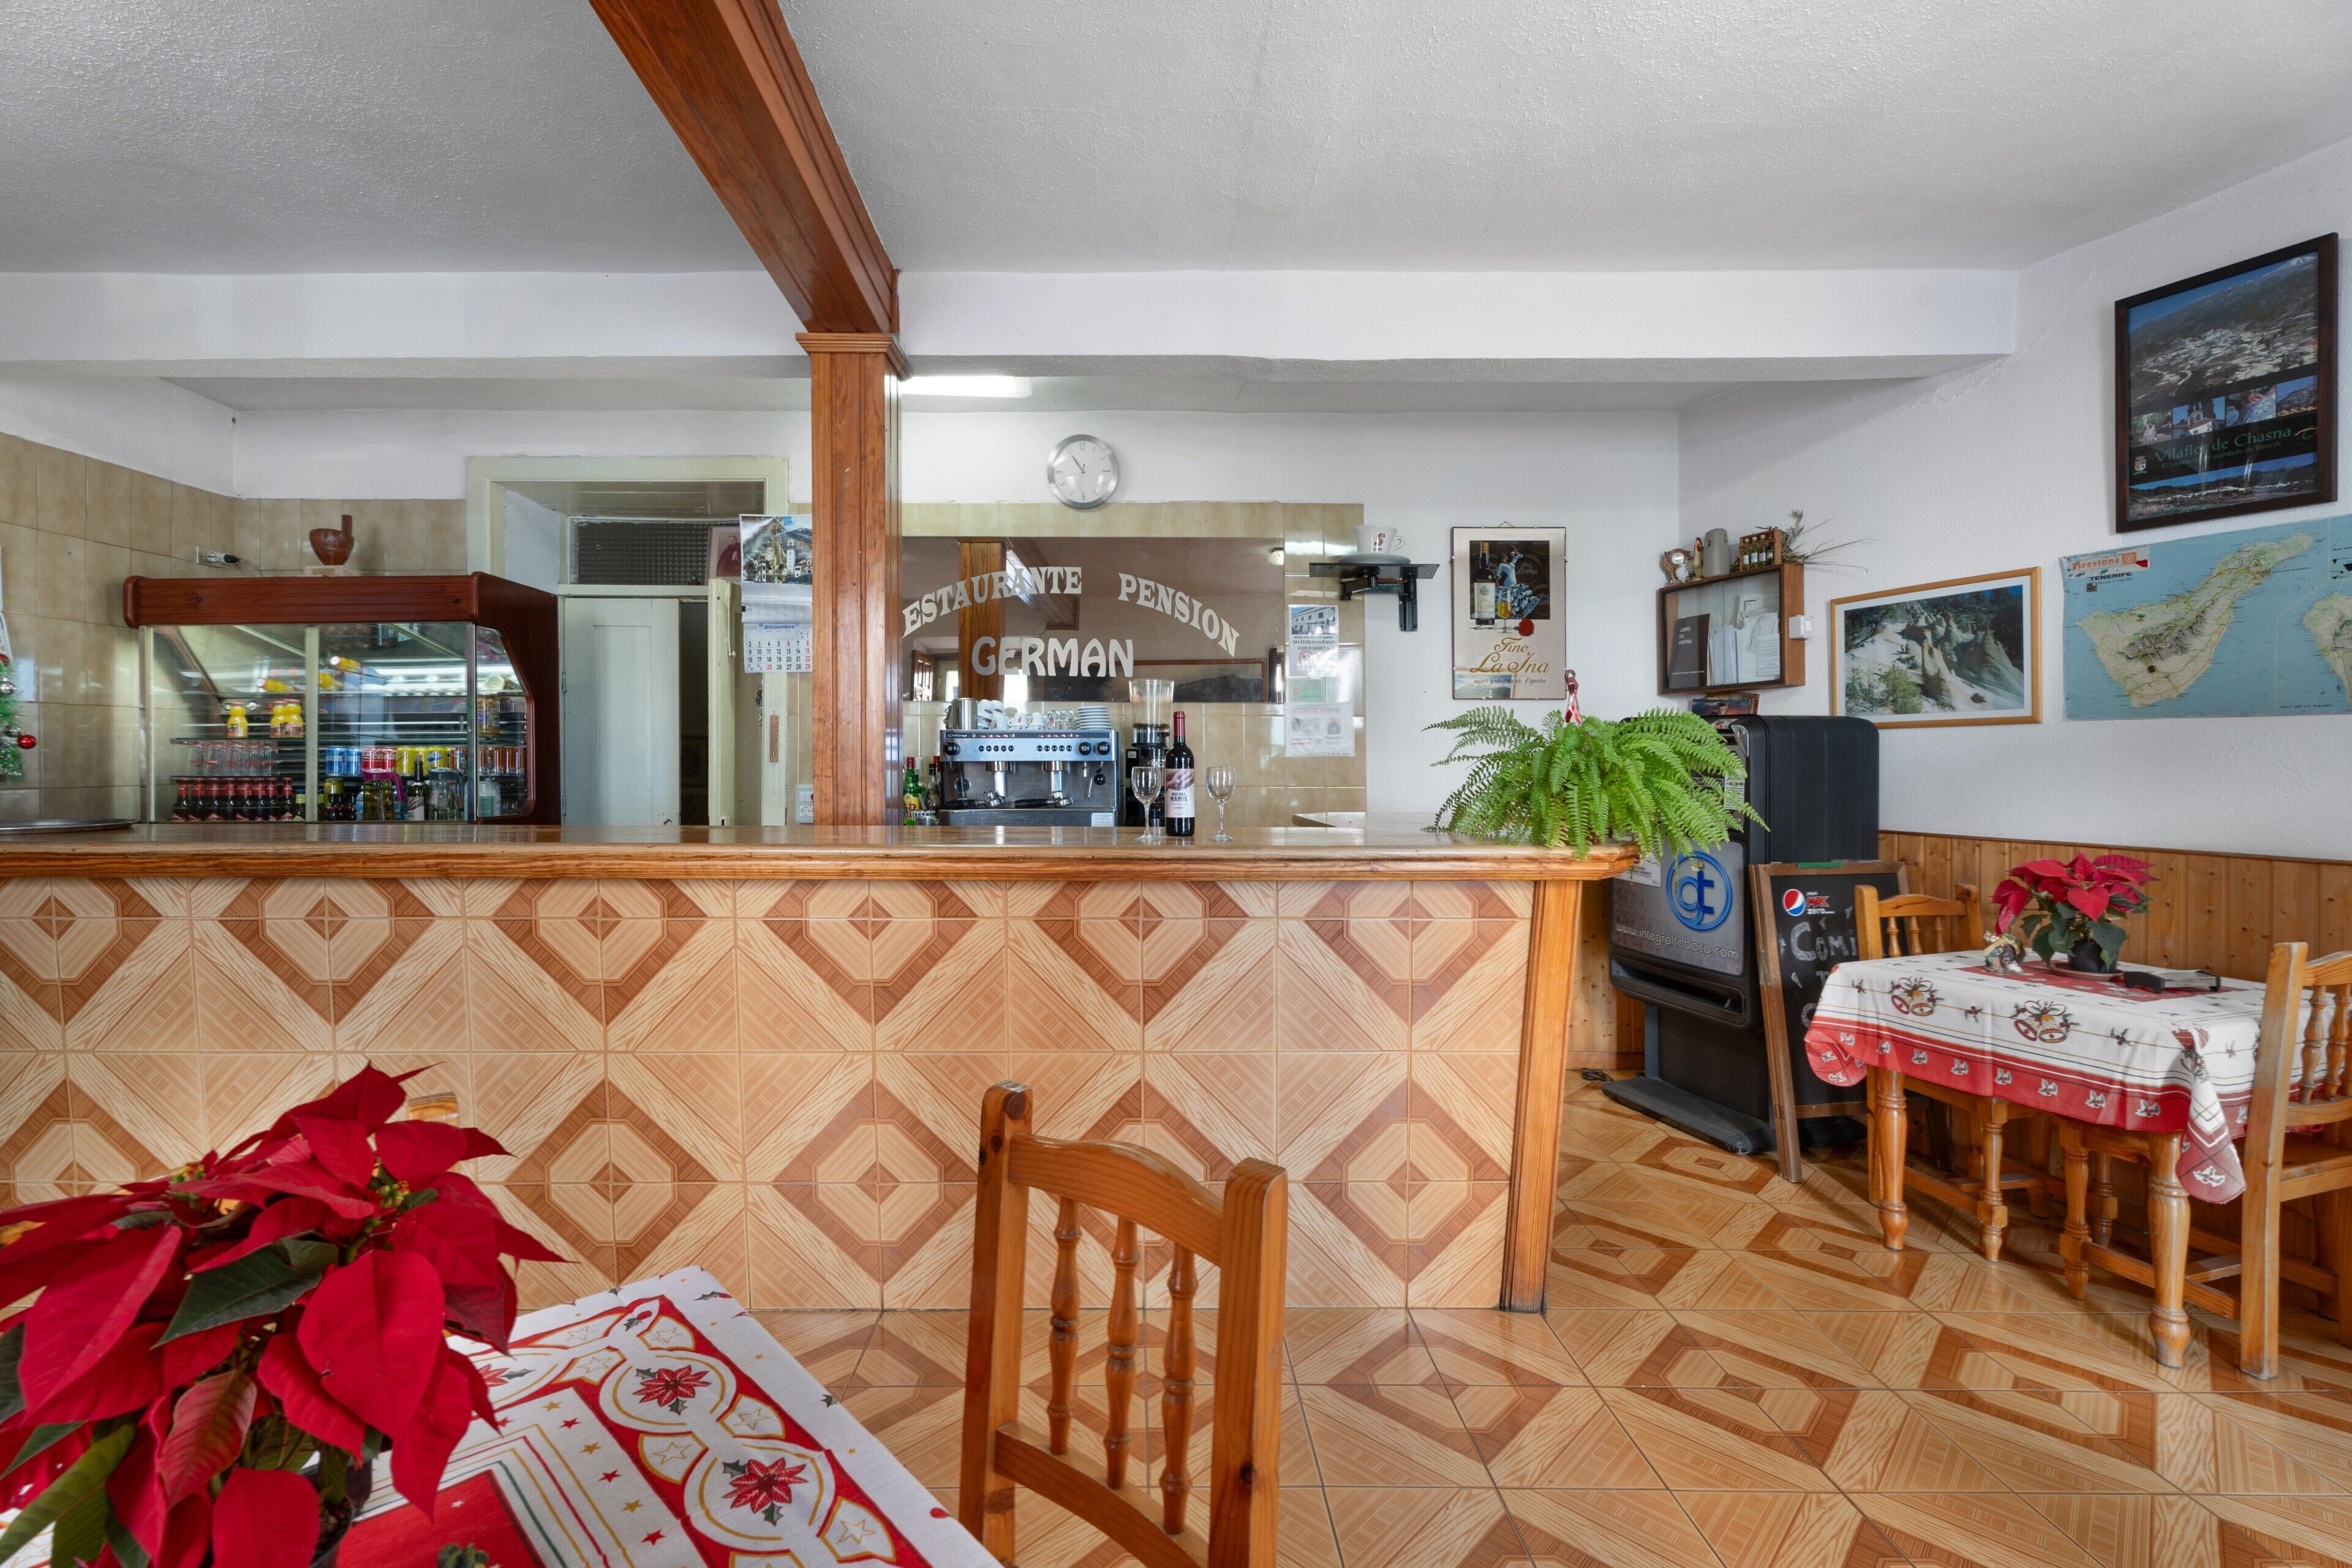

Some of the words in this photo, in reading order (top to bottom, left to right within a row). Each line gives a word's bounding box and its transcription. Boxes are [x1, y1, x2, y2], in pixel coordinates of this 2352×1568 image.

[2212, 438, 2229, 451] de
[2234, 428, 2291, 447] Chasna
[2089, 571, 2133, 581] TENERIFE
[1117, 573, 1240, 657] PENSION
[972, 636, 1134, 677] GERMAN
[1469, 652, 1503, 673] La
[1525, 677, 1547, 685] España
[1616, 922, 1740, 960] www.integraltabaco.com
